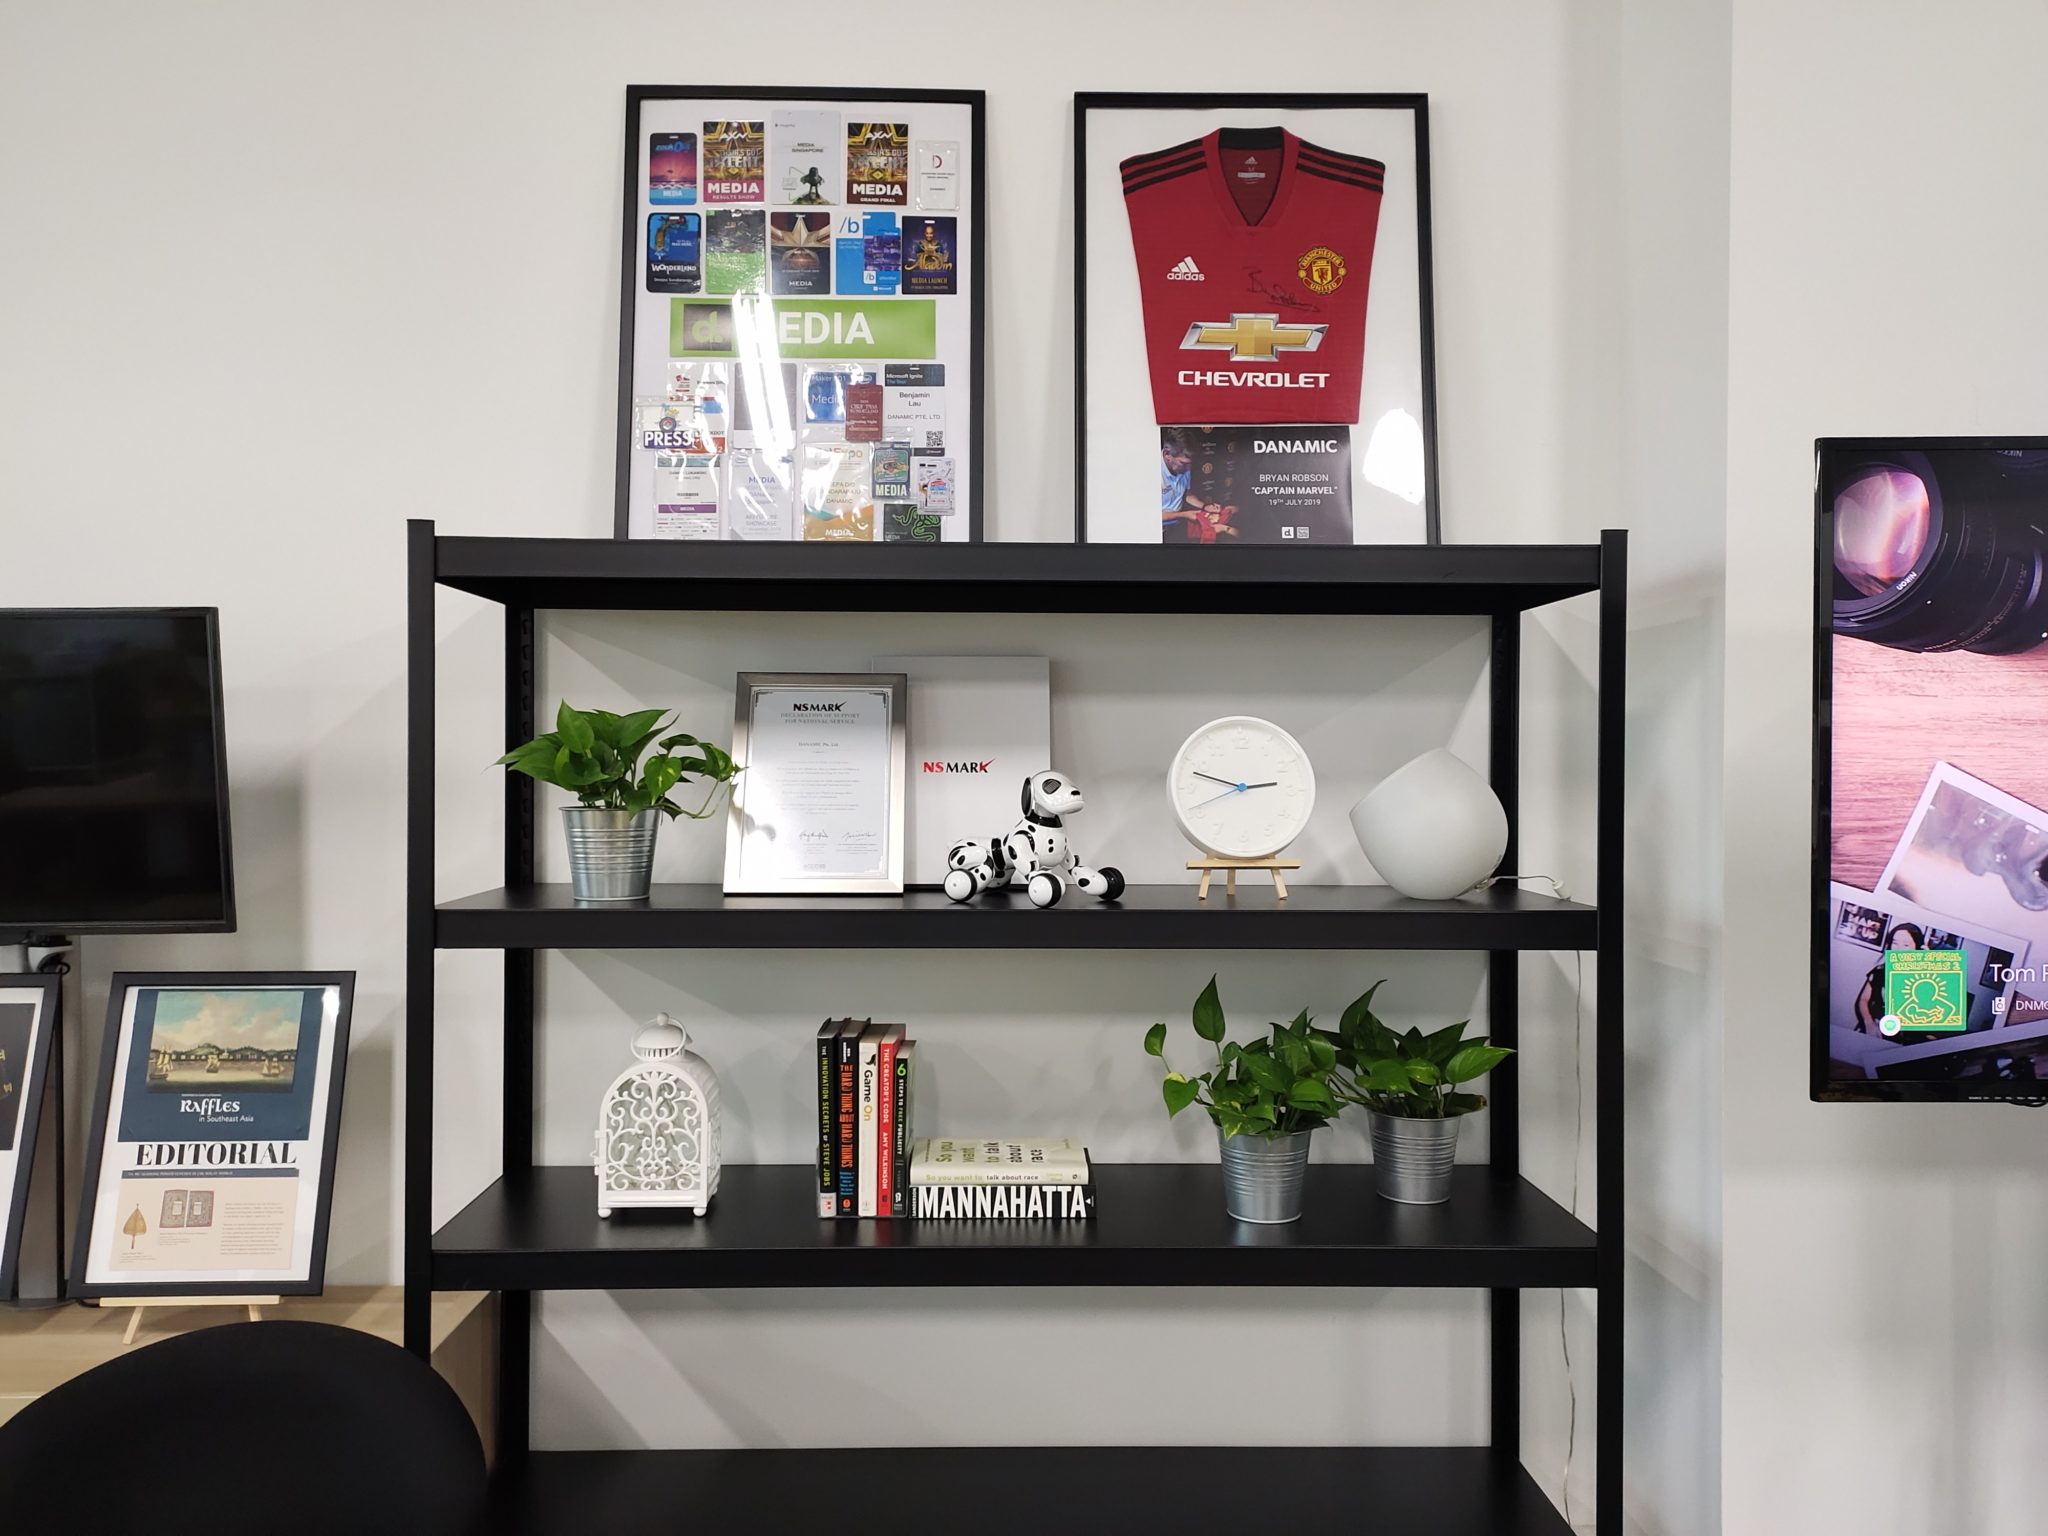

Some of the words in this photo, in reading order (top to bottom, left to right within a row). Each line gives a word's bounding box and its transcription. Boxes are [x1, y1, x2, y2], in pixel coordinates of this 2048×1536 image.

[708, 182, 760, 194] MEDIA
[852, 184, 902, 196] MEDIA
[1301, 248, 1343, 267] MANCHESTER
[1167, 272, 1204, 282] adidas
[1308, 282, 1338, 292] UNITED
[768, 312, 875, 344] EDIA
[1178, 370, 1330, 388] CHEVROLET
[811, 394, 840, 404] Medi
[644, 431, 692, 446] PRESS
[1254, 440, 1338, 454] DANAMIC
[1260, 474, 1290, 482] BRYAN
[1292, 474, 1328, 482] ROBSON
[876, 484, 907, 497] MEDIA
[1890, 953, 1898, 962] A
[1989, 964, 2035, 982] Tom
[897, 1064, 906, 1075] 6
[841, 1072, 853, 1092] HARD
[864, 1070, 873, 1103] Game
[180, 1098, 240, 1115] Raffles
[841, 1093, 853, 1112] THING
[864, 1104, 872, 1122] On
[841, 1124, 853, 1143] HARD
[136, 1142, 297, 1166] EDITORIAL
[942, 1142, 957, 1152] you
[984, 1142, 1000, 1154] talk
[1006, 1145, 1023, 1162] about
[841, 1144, 853, 1168] THINGS
[936, 1153, 952, 1162] So
[960, 1148, 975, 1162] want
[1031, 1149, 1044, 1163] race
[918, 1185, 1086, 1218] MANNAHATTA
